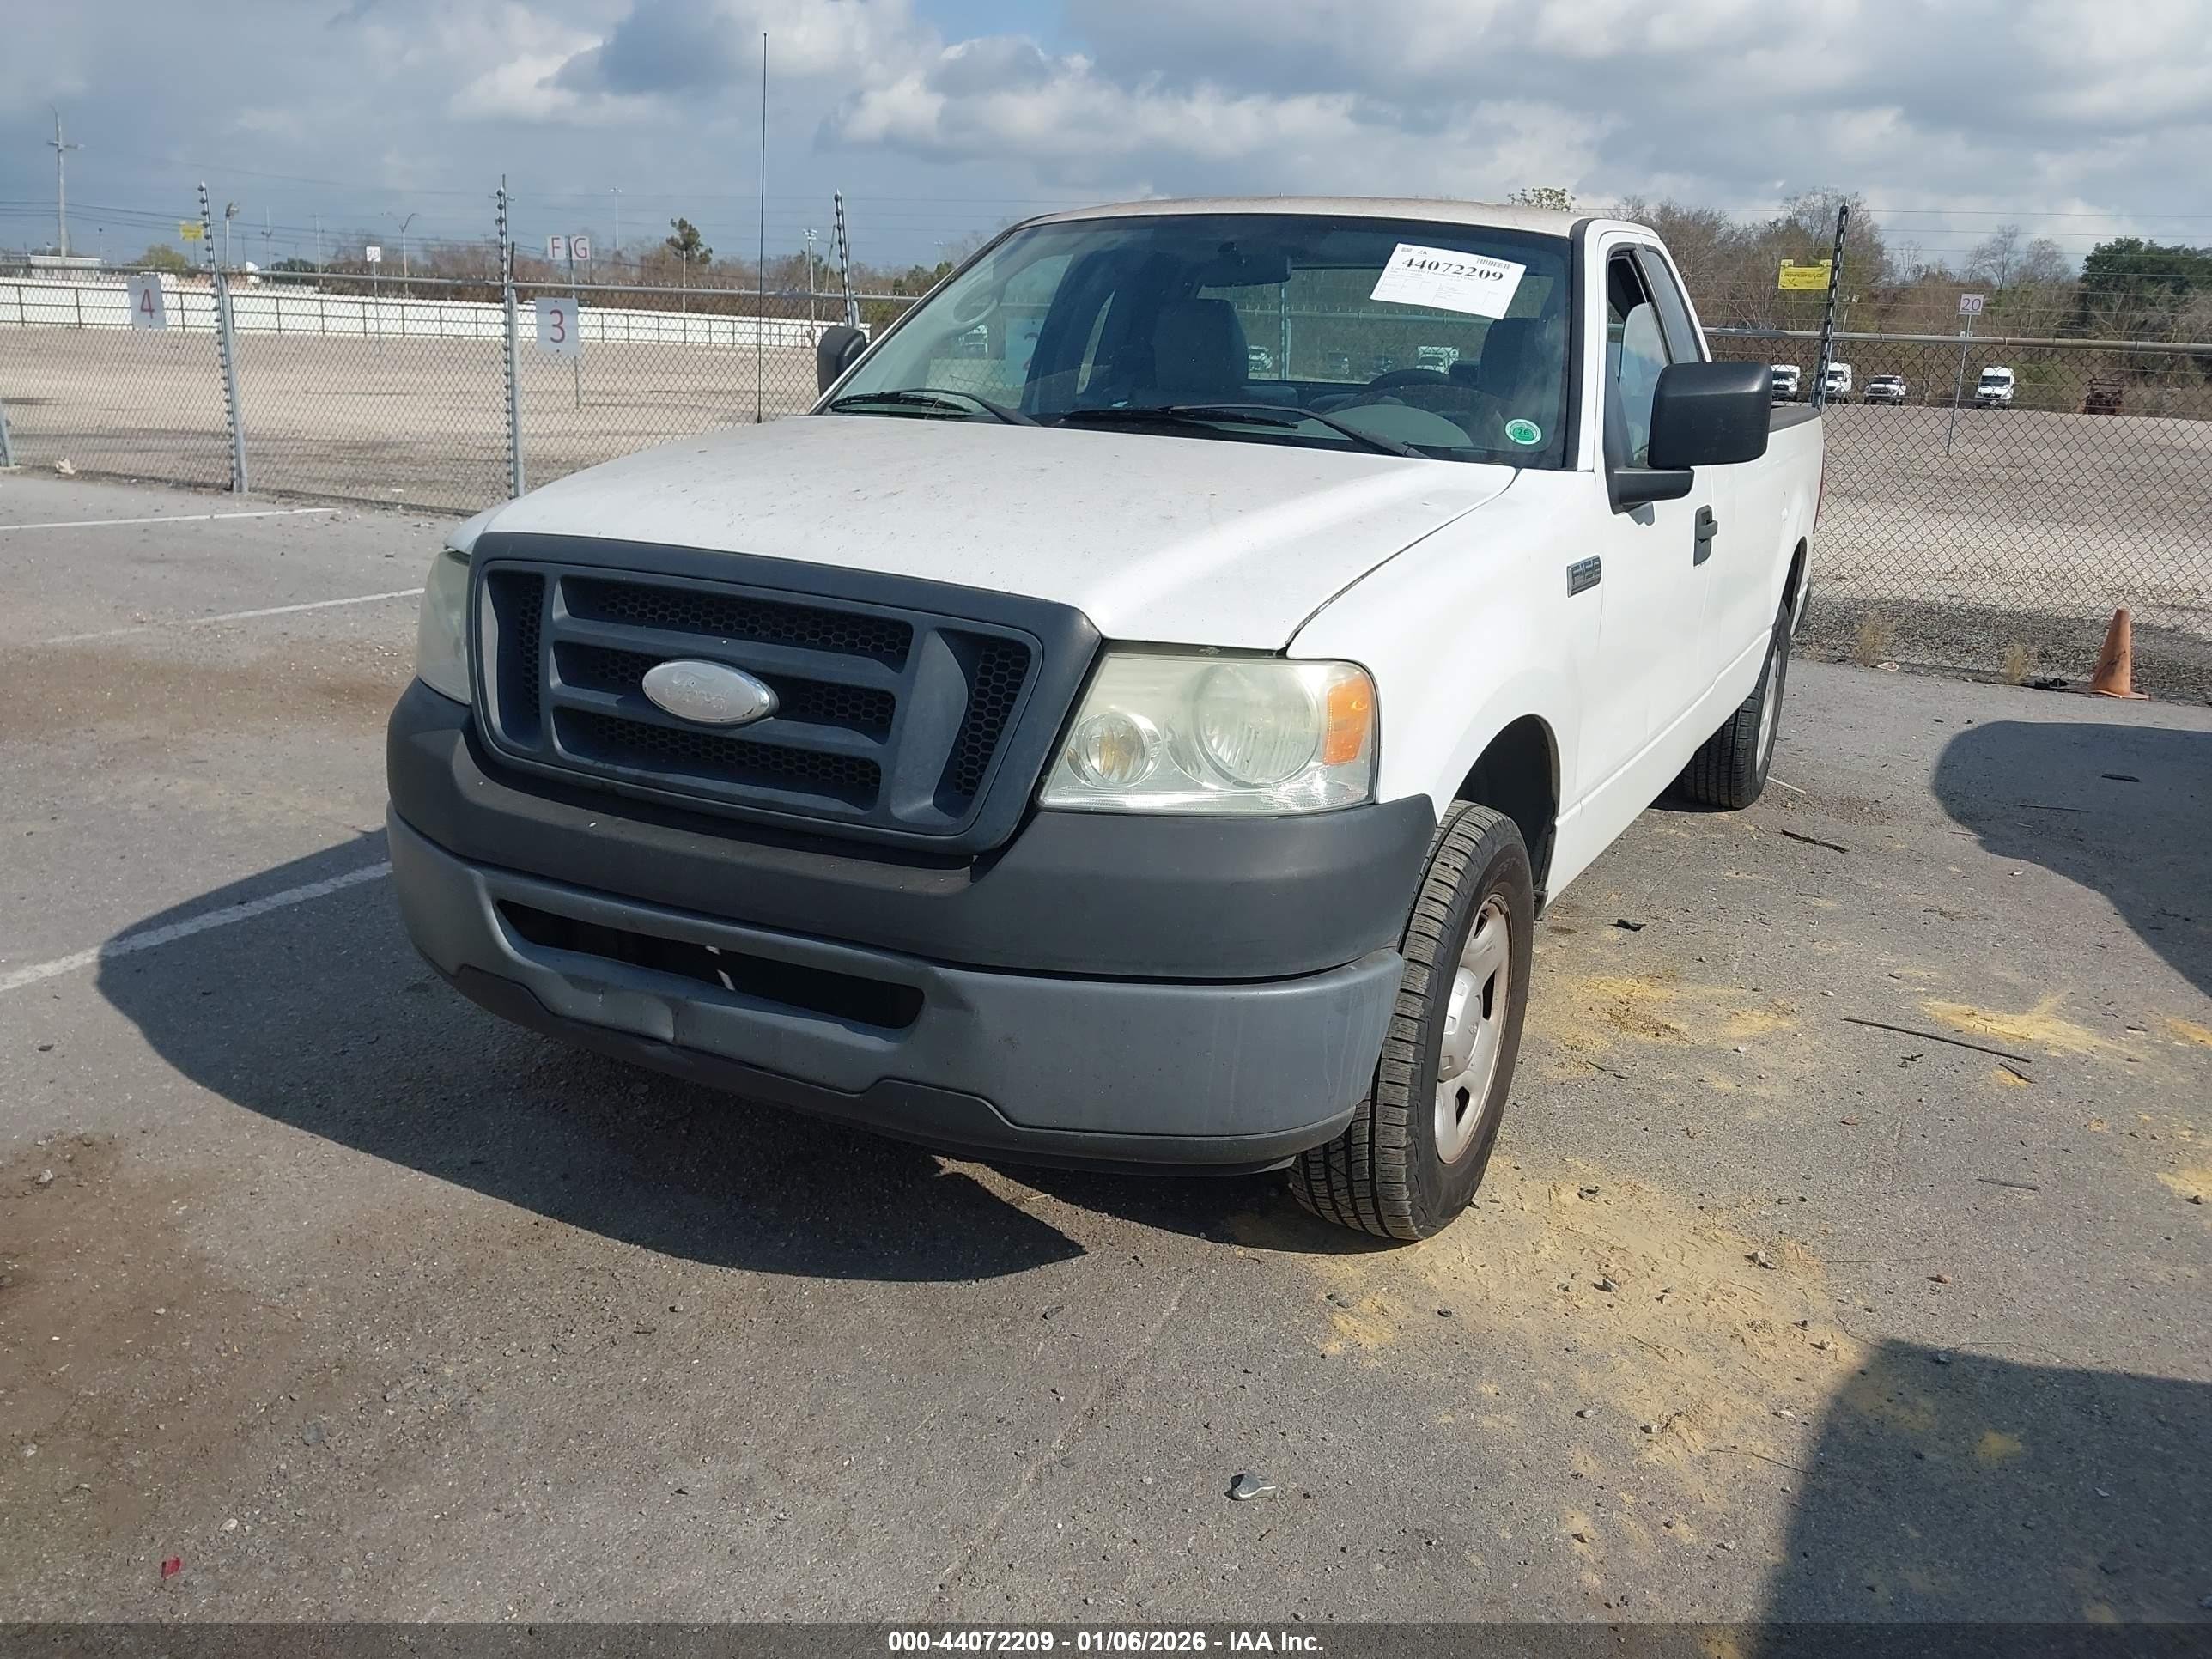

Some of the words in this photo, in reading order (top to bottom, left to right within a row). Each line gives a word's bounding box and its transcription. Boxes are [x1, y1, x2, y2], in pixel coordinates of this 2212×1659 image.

[550, 237, 561, 258] F
[574, 237, 588, 259] G
[1401, 257, 1504, 282] 44072209
[140, 288, 155, 319] 4
[1961, 297, 1982, 311] 20
[550, 309, 566, 343] 3
